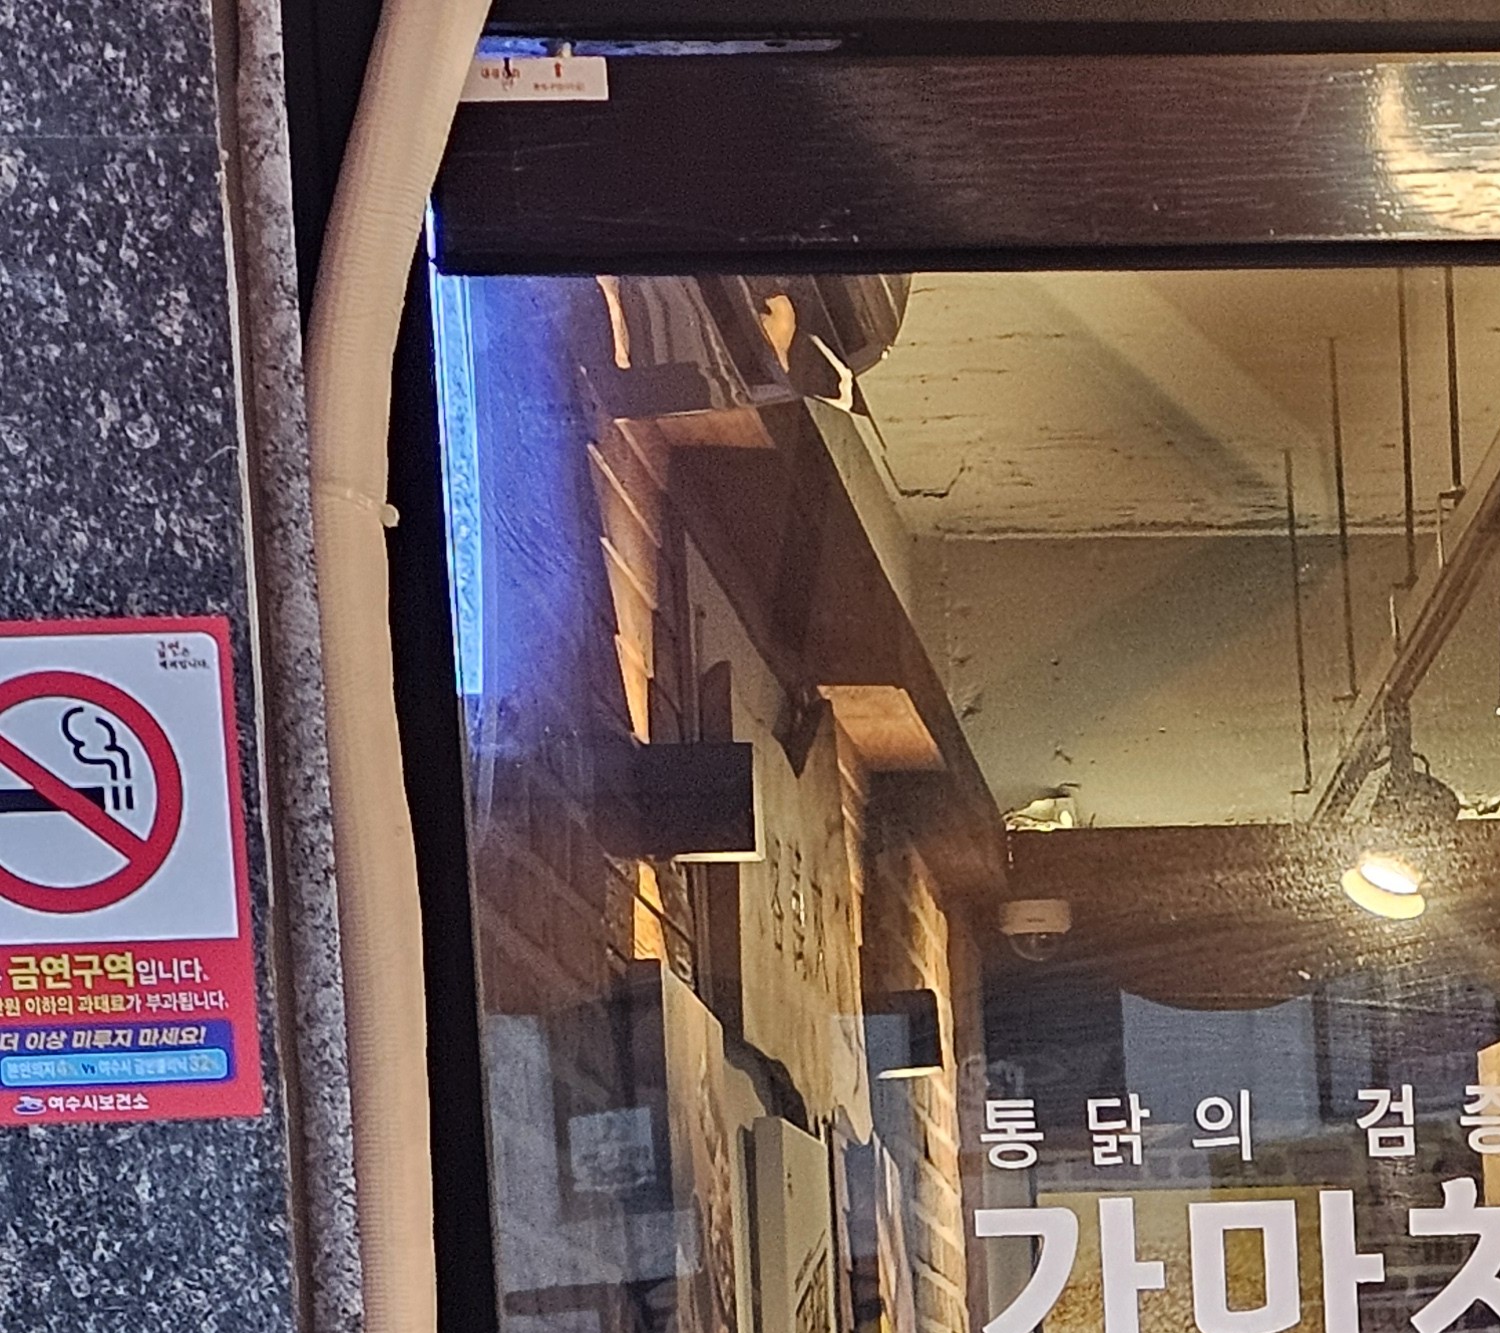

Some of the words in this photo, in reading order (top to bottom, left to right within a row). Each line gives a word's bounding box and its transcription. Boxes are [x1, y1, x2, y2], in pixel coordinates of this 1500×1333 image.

[7, 951, 210, 991] 금연구역입니다.
[25, 995, 74, 1016] 이하의
[77, 993, 142, 1013] 과태료가
[146, 989, 230, 1013] 부과됩니다.
[25, 1030, 68, 1051] 이상
[72, 1028, 133, 1049] 미루지
[138, 1026, 207, 1047] 마세요!
[48, 1092, 150, 1112] 여수시보건소
[979, 1087, 1253, 1169] 통닭의
